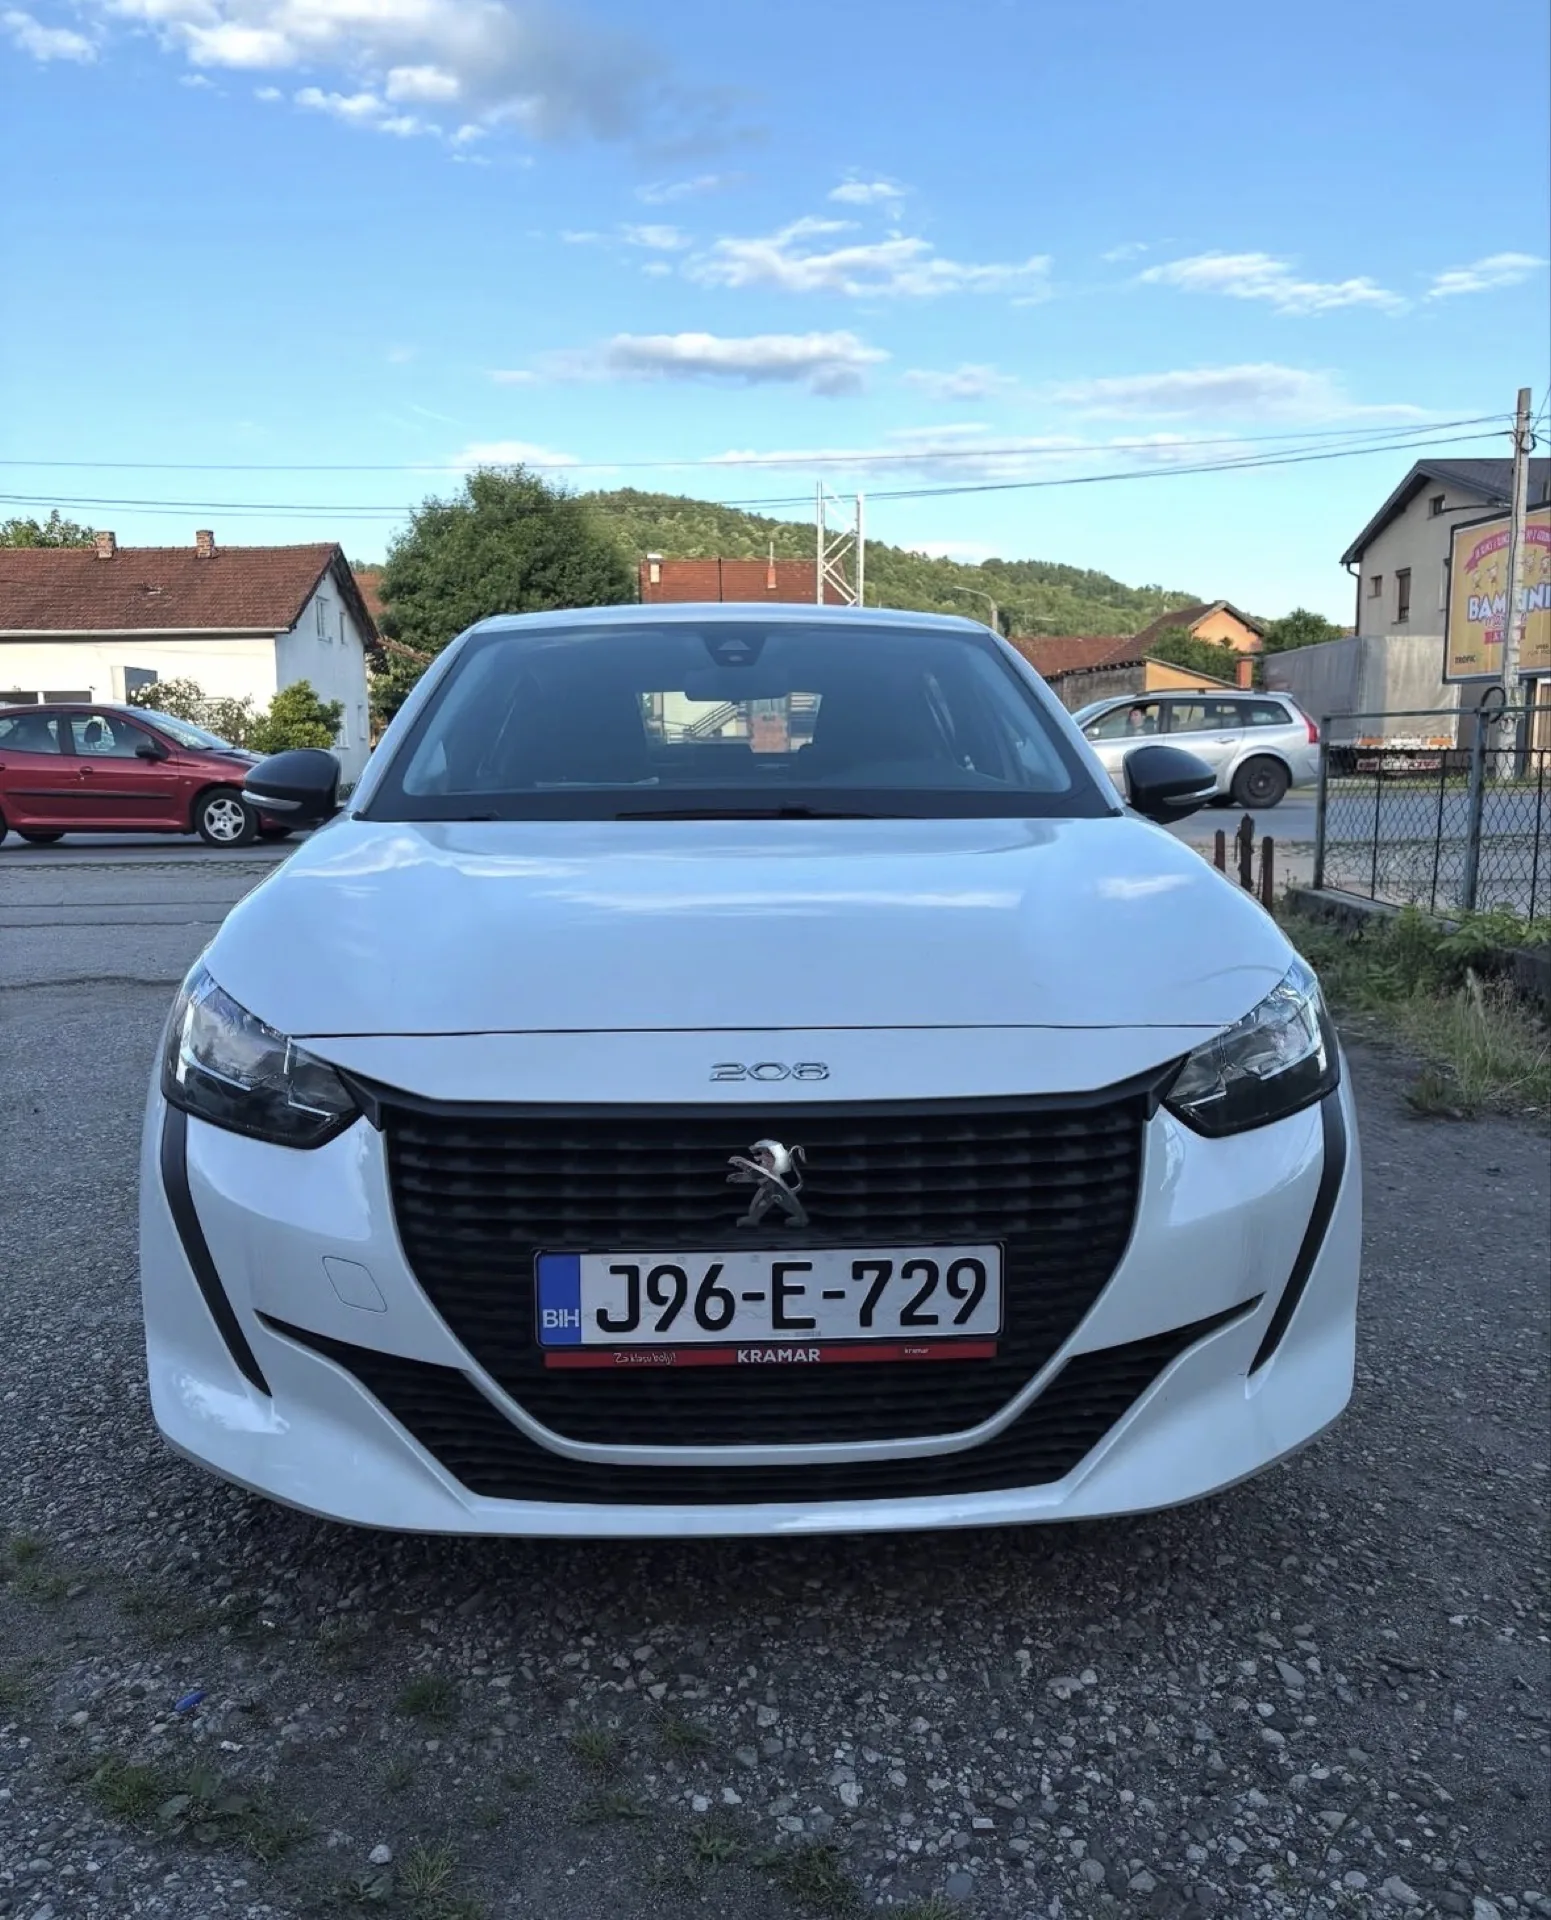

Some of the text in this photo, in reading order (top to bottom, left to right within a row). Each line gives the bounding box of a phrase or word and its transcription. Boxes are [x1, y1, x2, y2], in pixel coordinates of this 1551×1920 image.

[1467, 583, 1551, 622] BAMINI
[709, 1062, 831, 1082] 208
[542, 1257, 987, 1333] BIH J96-E-729
[737, 1348, 821, 1363] KRAMAR
